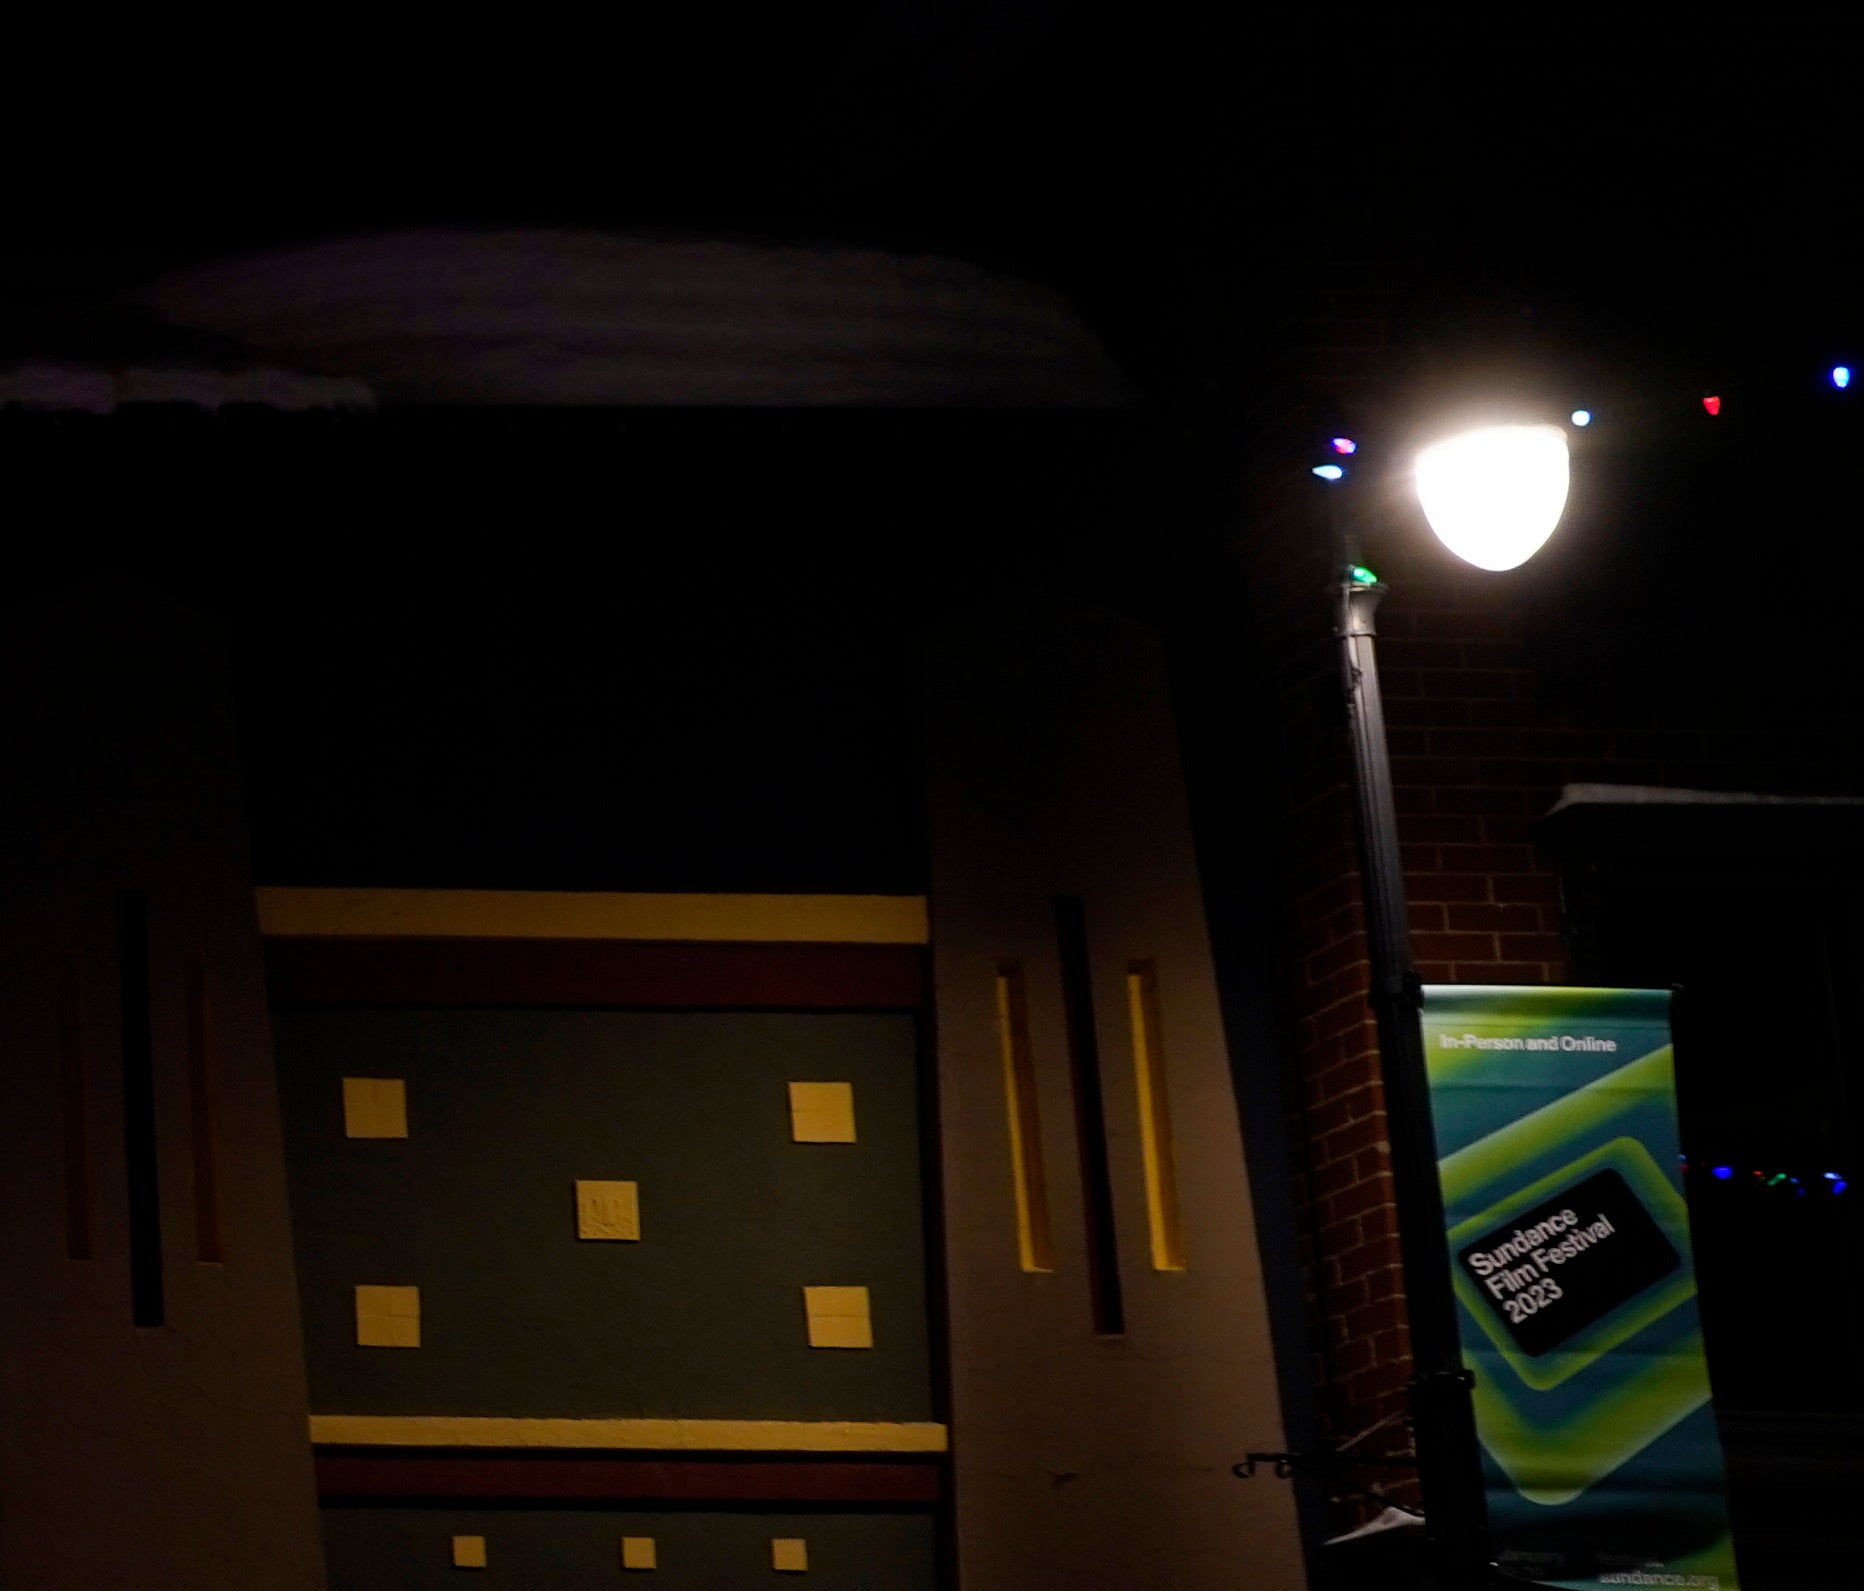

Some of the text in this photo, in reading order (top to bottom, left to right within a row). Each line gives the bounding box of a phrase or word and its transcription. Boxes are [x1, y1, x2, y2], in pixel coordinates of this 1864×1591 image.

[1440, 1033, 1617, 1052] In-Person and Online
[1467, 1208, 1579, 1276] Sundance
[1483, 1212, 1617, 1301] Film Festival
[1502, 1277, 1564, 1325] 2023
